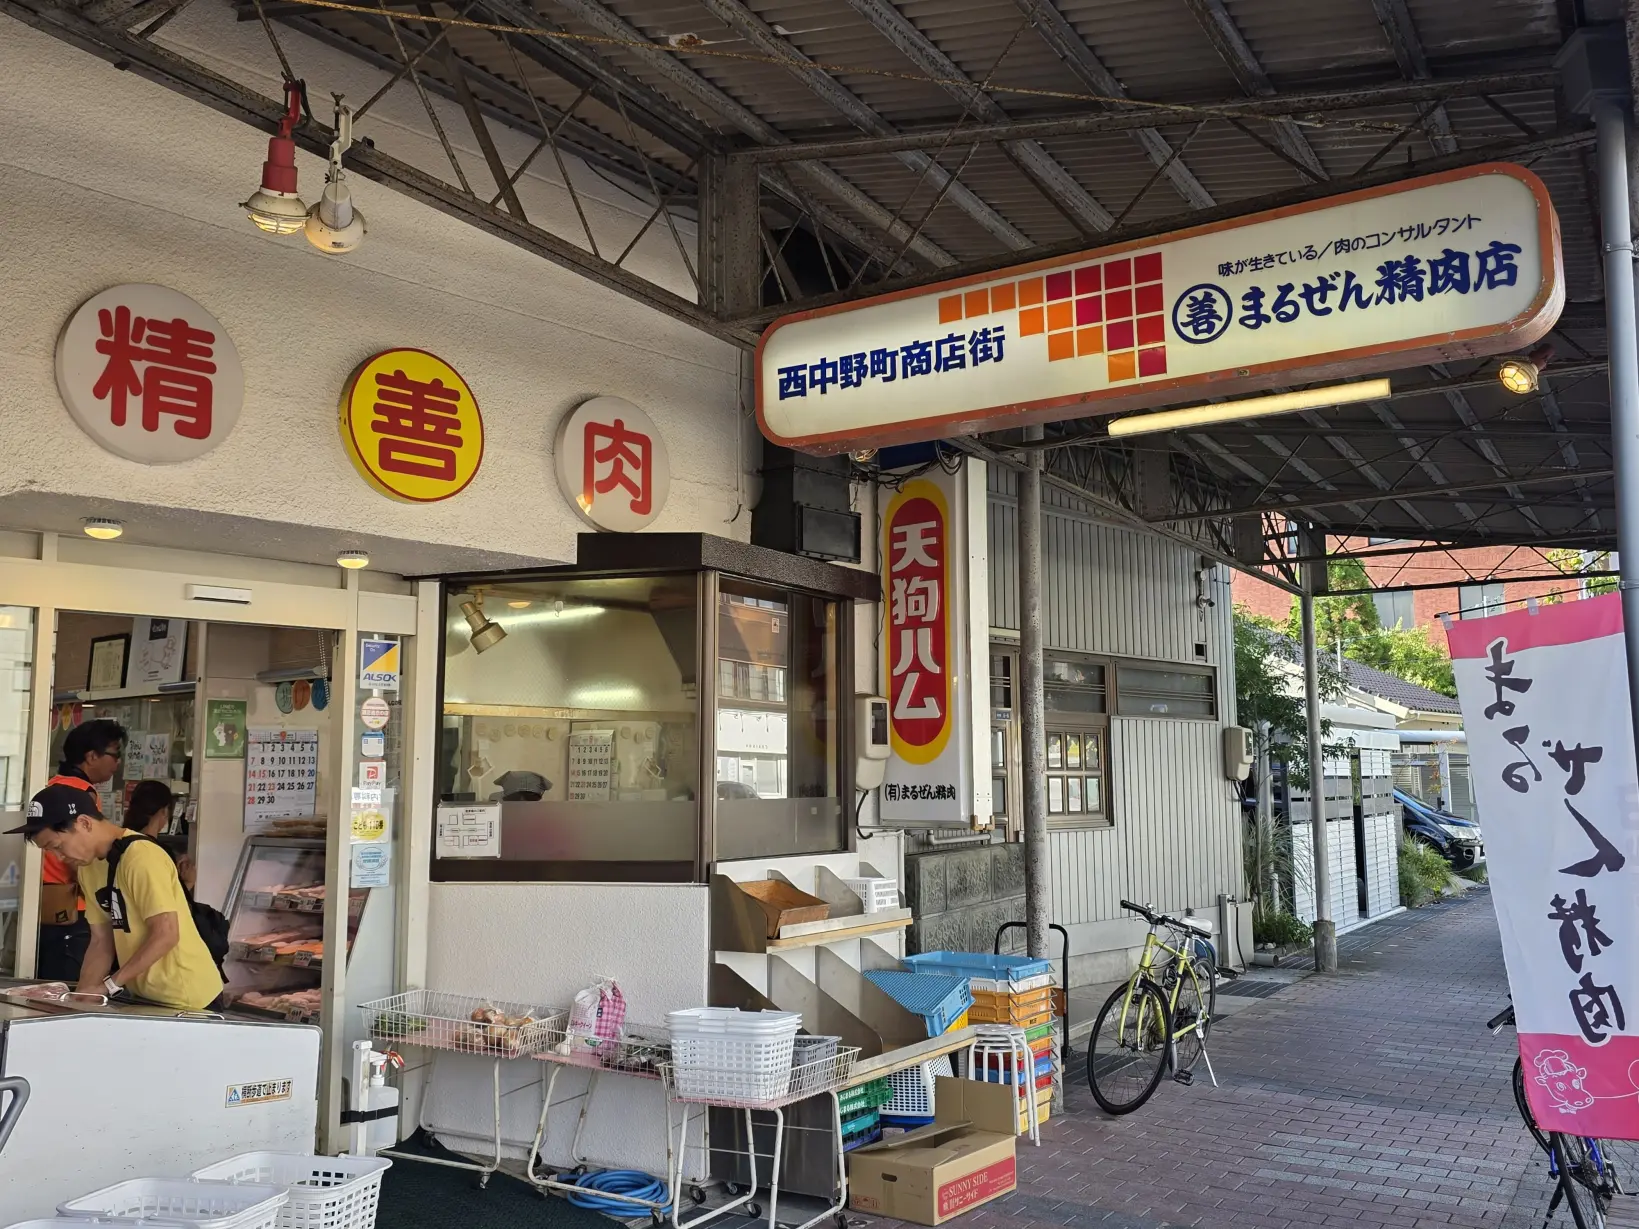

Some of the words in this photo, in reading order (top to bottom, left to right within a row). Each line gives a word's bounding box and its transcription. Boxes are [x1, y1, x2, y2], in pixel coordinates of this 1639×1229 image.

[1217, 213, 1482, 278] 味が生きている／肉のコンサルタント
[1238, 240, 1523, 330] まるぜん精肉店
[91, 304, 218, 441] 精
[777, 325, 1006, 401] 西中野町商店街
[370, 368, 464, 483] 善
[582, 417, 653, 516] 肉
[892, 520, 942, 721] 天狗ハム
[363, 672, 397, 683] ALSOK
[251, 757, 256, 765] 7
[260, 757, 265, 765] 8
[270, 756, 274, 764] 9
[278, 757, 286, 765] 10
[298, 756, 306, 764] 12
[308, 756, 315, 764] 13
[261, 744, 265, 752] 1
[271, 744, 276, 752] 2
[280, 744, 284, 752] 3
[290, 744, 294, 752] 4
[300, 743, 304, 752] 5
[310, 743, 314, 752] 6
[248, 770, 256, 778] 14
[259, 770, 266, 778] 15
[288, 770, 294, 778] 18
[298, 770, 304, 778] 19
[248, 783, 256, 792] 21
[257, 783, 266, 792] 22
[268, 783, 275, 791] 23
[277, 782, 284, 790] 24
[287, 782, 294, 790] 25
[296, 782, 304, 790] 26
[247, 796, 255, 804] 28
[257, 796, 265, 804] 29
[266, 796, 275, 804] 30
[884, 783, 956, 802] (有)まるぜん精肉
[948, 1177, 973, 1198] SUNNY
[972, 1171, 989, 1187] SIDE
